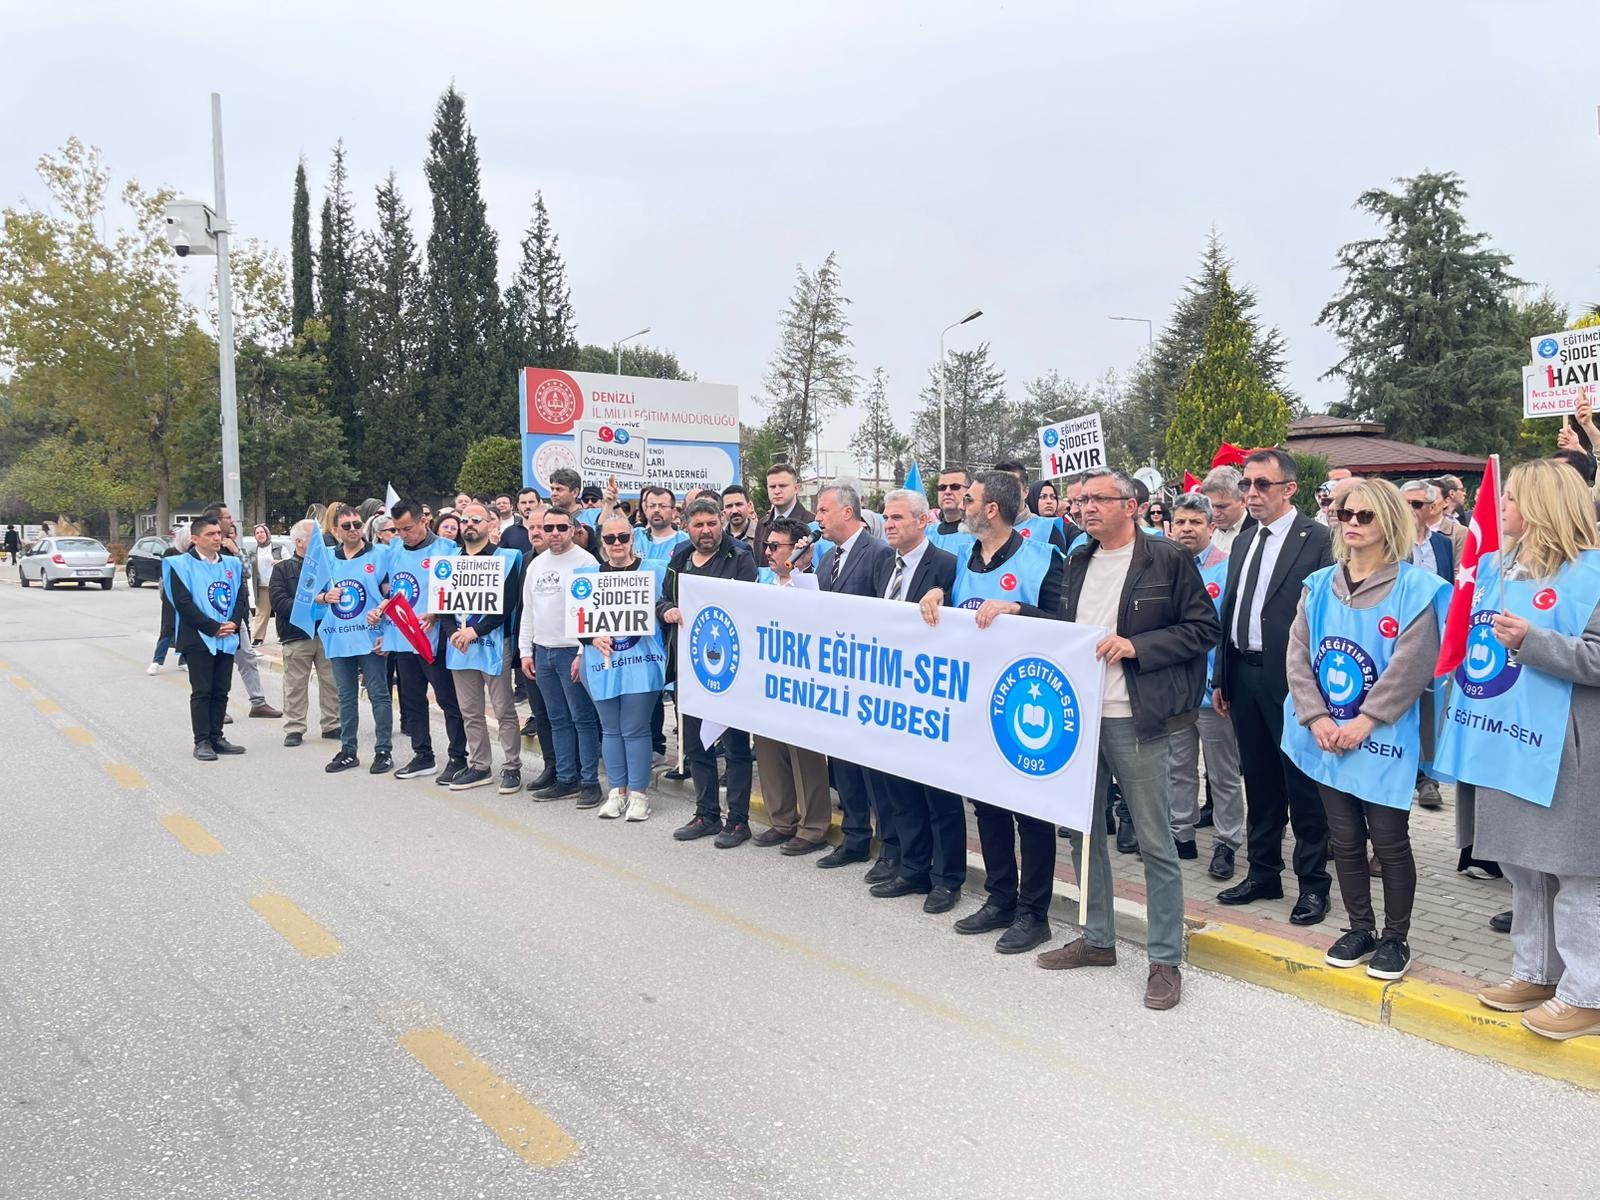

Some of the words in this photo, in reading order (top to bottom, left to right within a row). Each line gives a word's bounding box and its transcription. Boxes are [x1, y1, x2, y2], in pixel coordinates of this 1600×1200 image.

[592, 390, 635, 404] DENİZLİ
[592, 407, 601, 419] İL
[1533, 401, 1555, 411] KAN
[1060, 418, 1097, 436] EĞİTİMCİYE
[1059, 430, 1099, 454] ŞİDDETE
[675, 468, 708, 479] DERNEĞİ
[456, 559, 500, 571] EĞİTİMCİYE
[451, 571, 499, 590] ŞİDDETE
[597, 575, 650, 588] EĞİTİMCİYE
[592, 588, 650, 609] ŞİDDETE
[691, 610, 710, 665] TÜRKİYE
[611, 653, 663, 669] EĞİTİM-SEN
[756, 621, 811, 670] TÜRK
[818, 630, 970, 703] EĞİTİM-SEN
[1325, 638, 1374, 691] EĞİTİM-SEN
[707, 678, 721, 690] 1992
[1463, 682, 1485, 696] 1992
[993, 672, 1017, 716] TÜRK
[1018, 661, 1075, 733] EĞİTİM-SEN
[765, 673, 850, 717] DENİZLİ
[857, 694, 951, 742] ŞUBESİ
[1454, 708, 1543, 748] EĞİTİM-SEN
[1017, 754, 1046, 771] 1992
